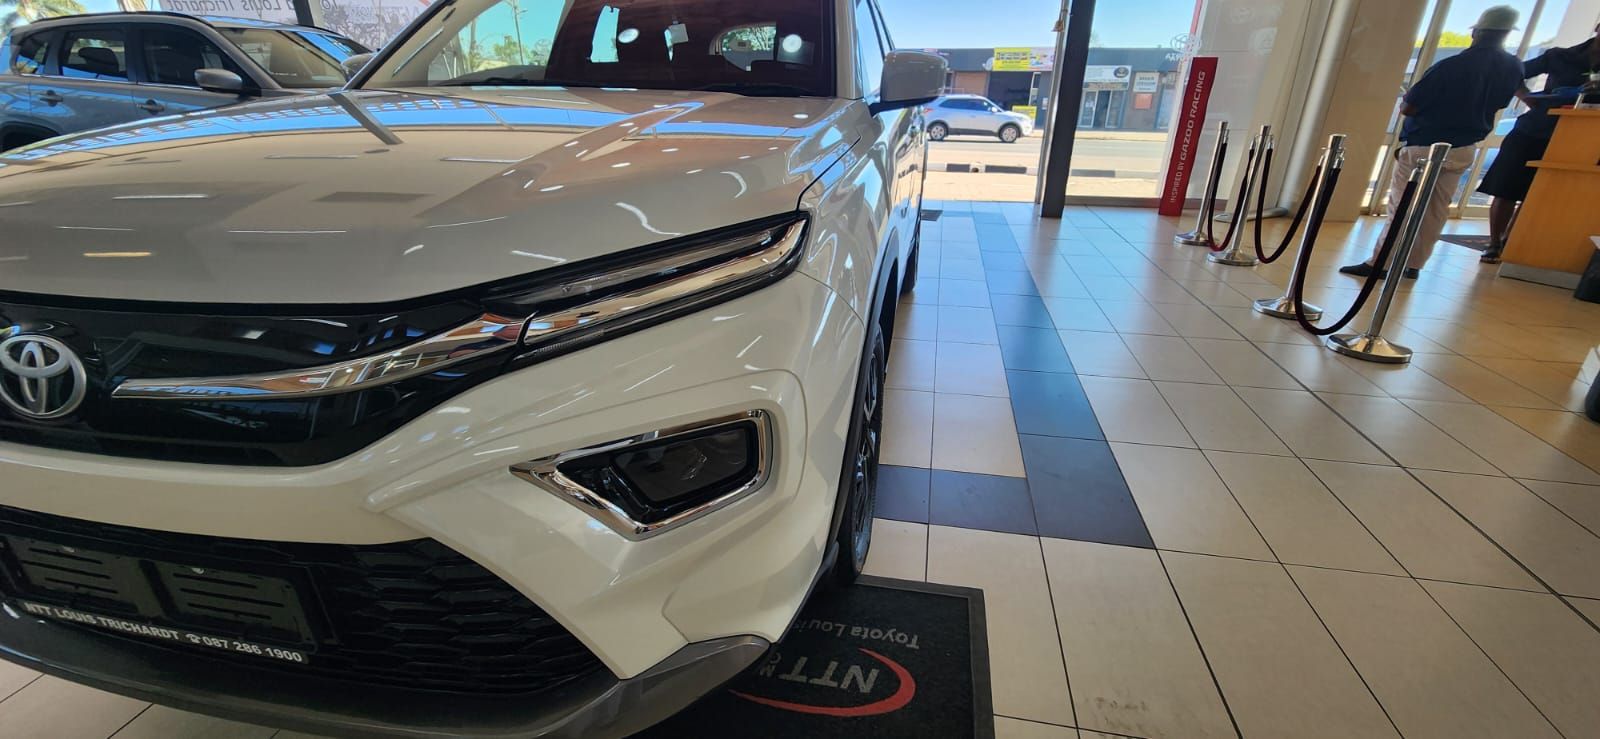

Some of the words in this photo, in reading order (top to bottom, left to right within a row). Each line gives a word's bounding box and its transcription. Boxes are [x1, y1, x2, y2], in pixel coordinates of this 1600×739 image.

[1170, 171, 1183, 203] INSPIRED
[1180, 119, 1194, 160] GAZOO
[1189, 71, 1206, 118] RACING
[24, 602, 55, 618] NTT
[55, 607, 97, 625] LOUIS
[98, 616, 180, 641] TRICHARDT
[203, 636, 230, 649] 087
[233, 641, 262, 656] 286
[265, 647, 303, 664] 1900
[850, 625, 920, 650] Toyota
[779, 656, 881, 694] NTT
